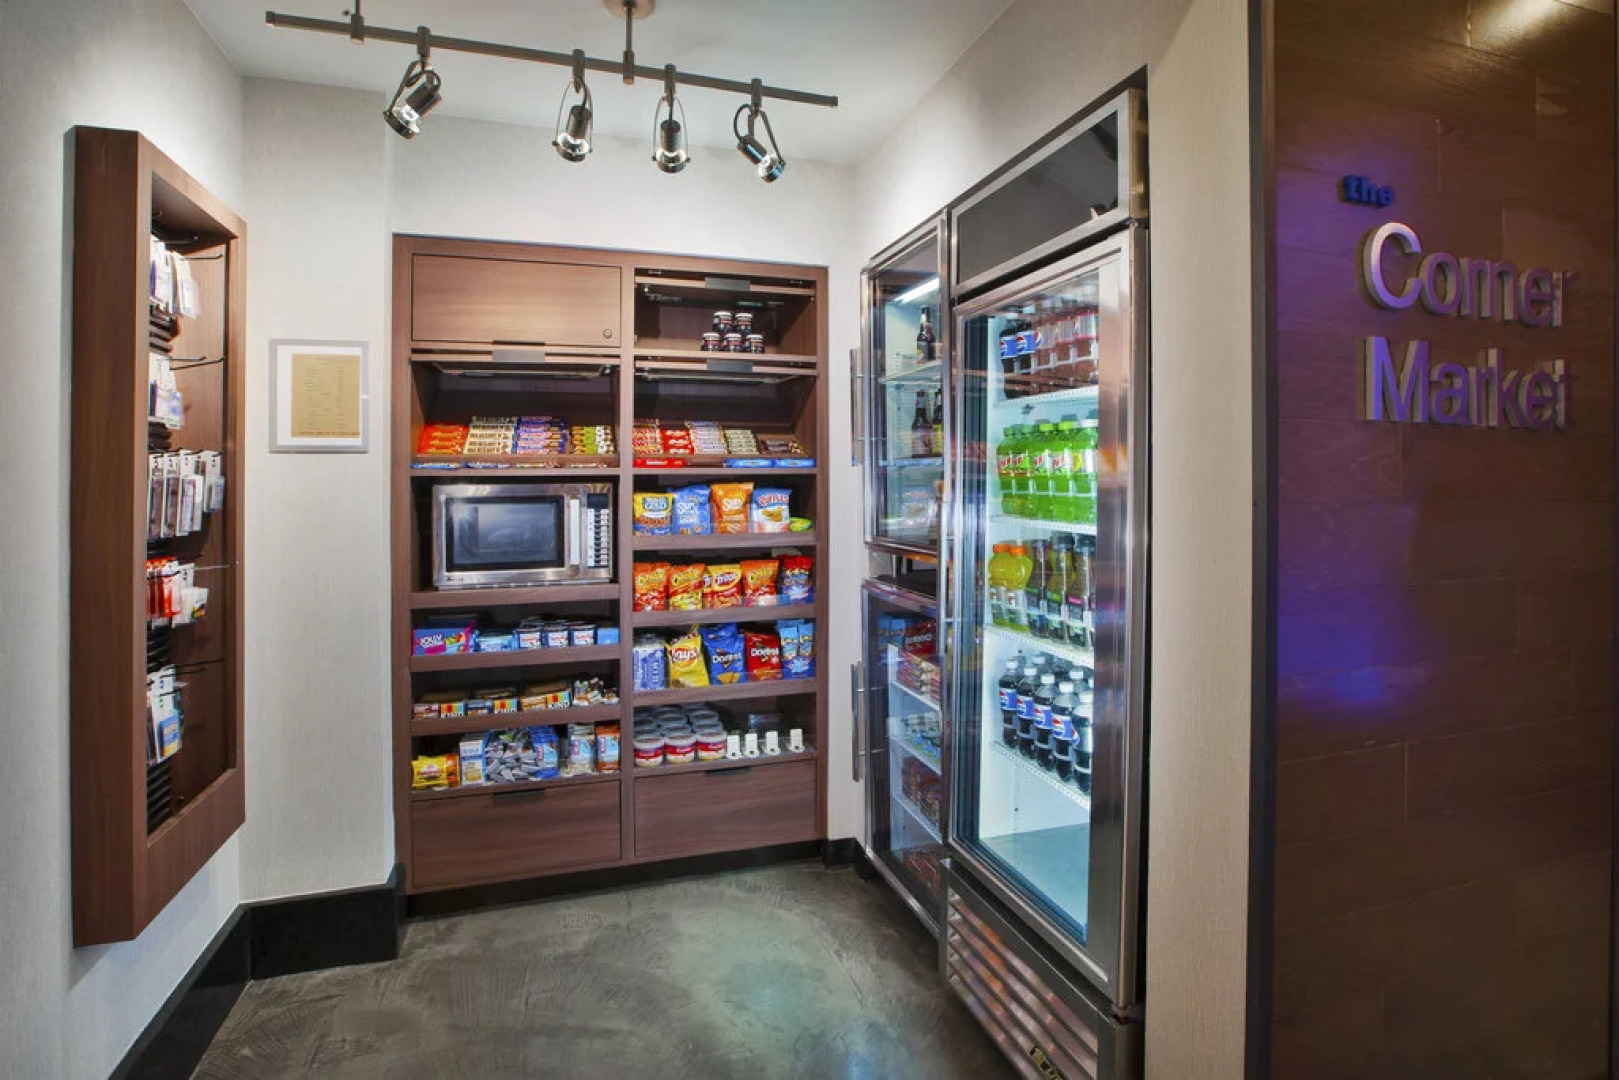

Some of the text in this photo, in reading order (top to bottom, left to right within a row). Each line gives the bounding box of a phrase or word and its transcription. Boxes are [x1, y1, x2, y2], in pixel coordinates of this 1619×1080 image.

[1343, 174, 1395, 207] the
[1362, 222, 1577, 327] Corner
[1364, 336, 1576, 431] Market
